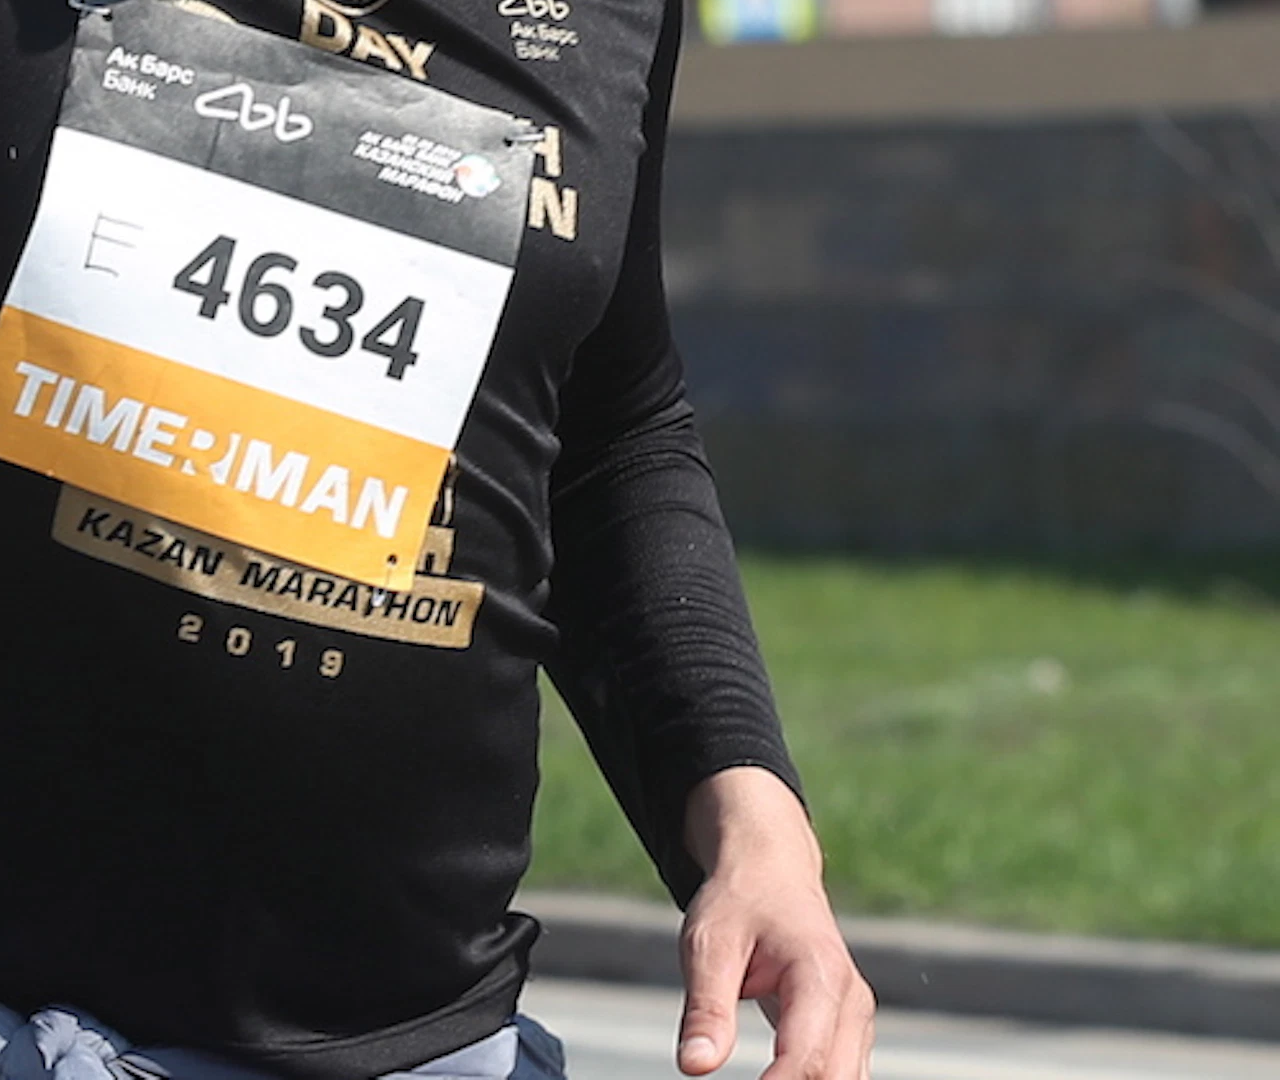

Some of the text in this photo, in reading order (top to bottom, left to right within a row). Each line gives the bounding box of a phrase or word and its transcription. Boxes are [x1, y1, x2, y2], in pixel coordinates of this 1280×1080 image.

[102, 69, 157, 101] Банк
[106, 46, 195, 86] Ак Барс
[172, 233, 426, 381] 4634
[76, 505, 464, 628] KAZAN MARATHON
[177, 611, 346, 679] 2019
